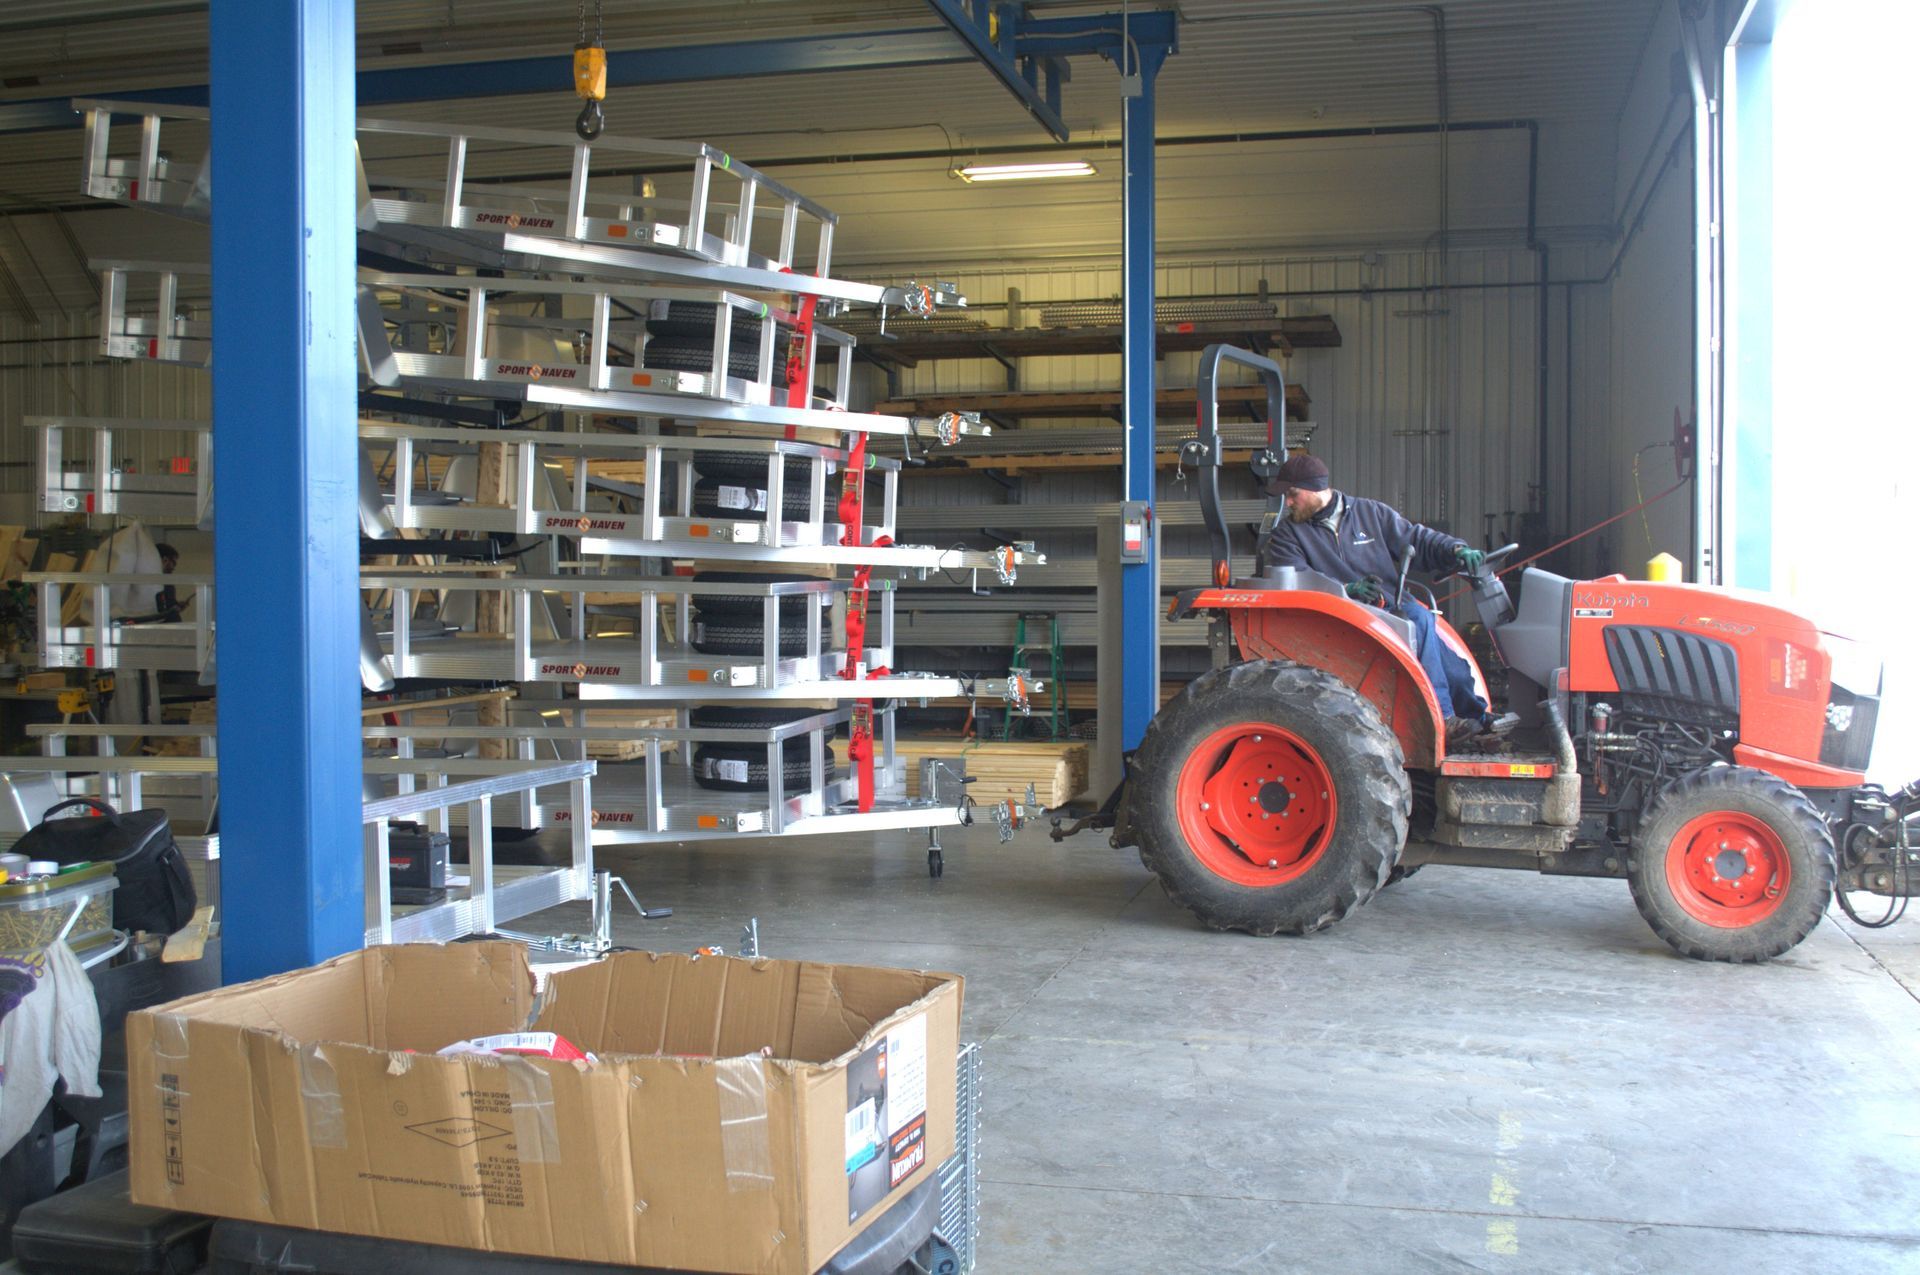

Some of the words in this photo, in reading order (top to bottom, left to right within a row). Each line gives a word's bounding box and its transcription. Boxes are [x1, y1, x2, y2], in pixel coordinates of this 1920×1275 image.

[476, 213, 509, 224] SPORT
[519, 216, 554, 228] HAVEN
[497, 365, 531, 375] SPORT
[541, 367, 576, 378] HAVEN
[546, 518, 580, 527] SPORT
[590, 519, 625, 530] HAVEN
[1576, 592, 1649, 607] Kubota
[541, 664, 576, 674] SPORT
[585, 666, 621, 676] HAVEN
[599, 811, 634, 822] HAVEN
[892, 1140, 924, 1183] FRANKLIN
